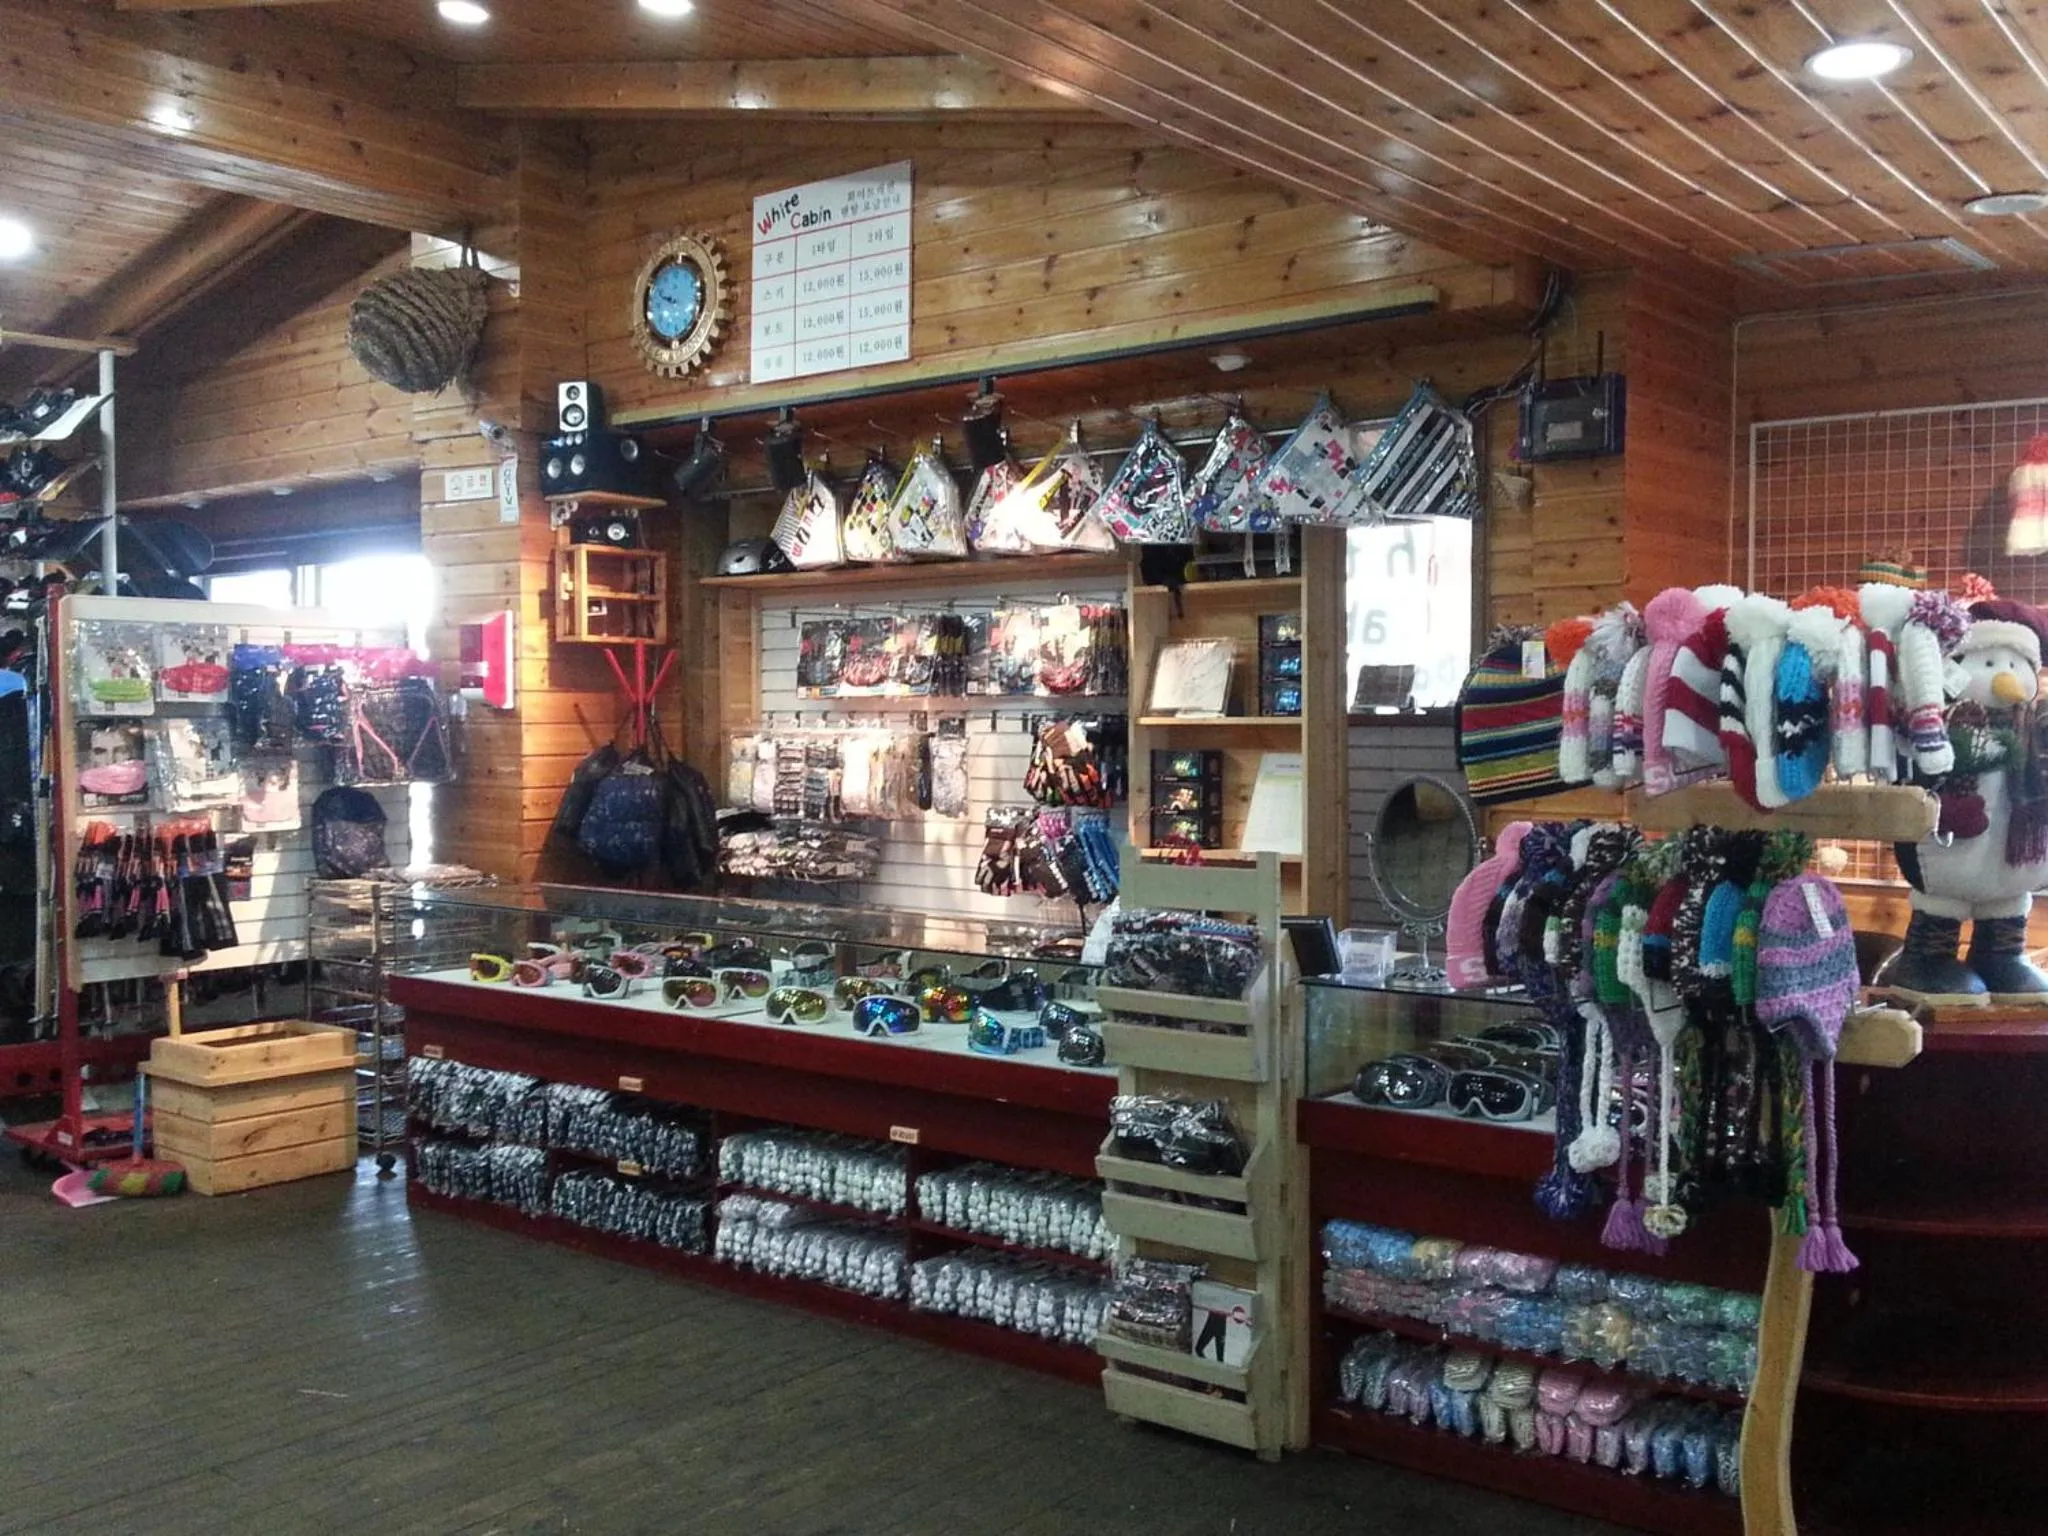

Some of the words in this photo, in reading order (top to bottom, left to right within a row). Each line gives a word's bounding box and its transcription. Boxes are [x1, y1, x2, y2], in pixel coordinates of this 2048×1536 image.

[757, 193, 800, 236] White
[790, 208, 832, 230] Cabin
[503, 468, 513, 505] CCTV
